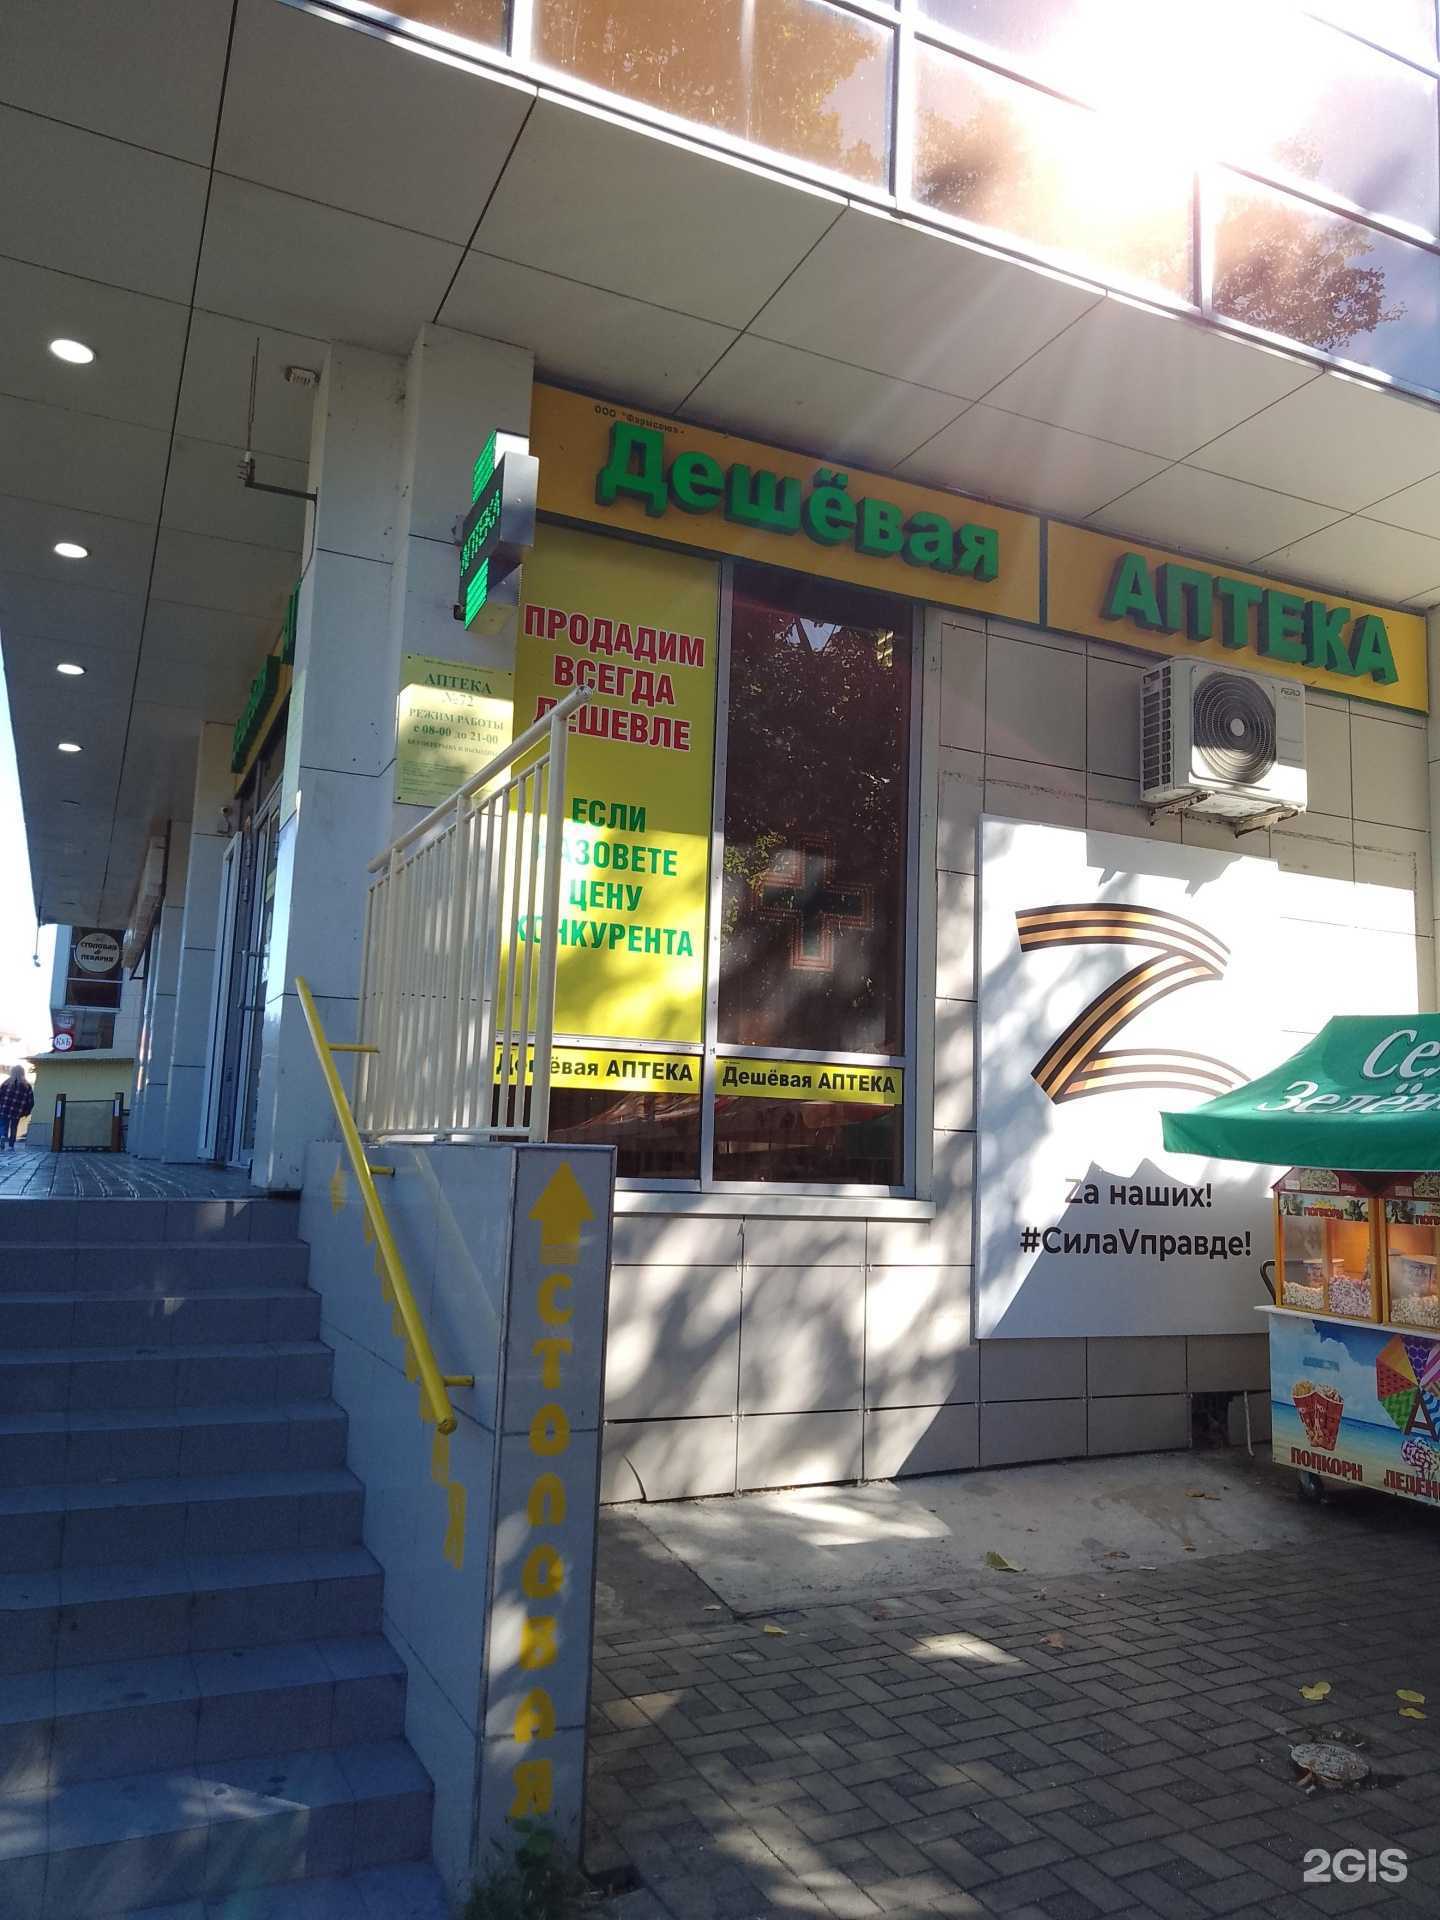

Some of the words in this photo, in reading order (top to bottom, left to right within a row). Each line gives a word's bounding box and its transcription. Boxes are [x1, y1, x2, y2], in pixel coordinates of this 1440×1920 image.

[595, 420, 999, 582] Дешёвая
[1099, 551, 1399, 687] АПТЕКА
[524, 604, 705, 667] ПРОДАДИМ
[424, 673, 492, 695] АПТЕКА
[554, 654, 675, 708] ВСЕГДА
[409, 707, 454, 722] РЕЖИМ
[457, 715, 504, 731] РАБОТЫ
[422, 724, 452, 737] 08-00
[470, 731, 499, 745] 21-00
[533, 696, 691, 752] ДШЕВЛЕ
[572, 797, 647, 833] ЕСЛИ
[569, 879, 644, 912] ЦЕНУ
[605, 1058, 693, 1082] АПТЕКА
[1363, 1029, 1440, 1078] Се
[722, 1066, 812, 1088] Дешёвая
[818, 1072, 895, 1094] АПТЕКА
[1256, 1081, 1440, 1113] Зелён
[1110, 1183, 1212, 1208] наших!
[1019, 1226, 1251, 1261] #СилаVправде!
[1290, 1446, 1363, 1482] ПОПКОРН
[1384, 1469, 1440, 1502] ЛЕДЕН
[511, 1274, 575, 1818] СТОЛОВАЯ
